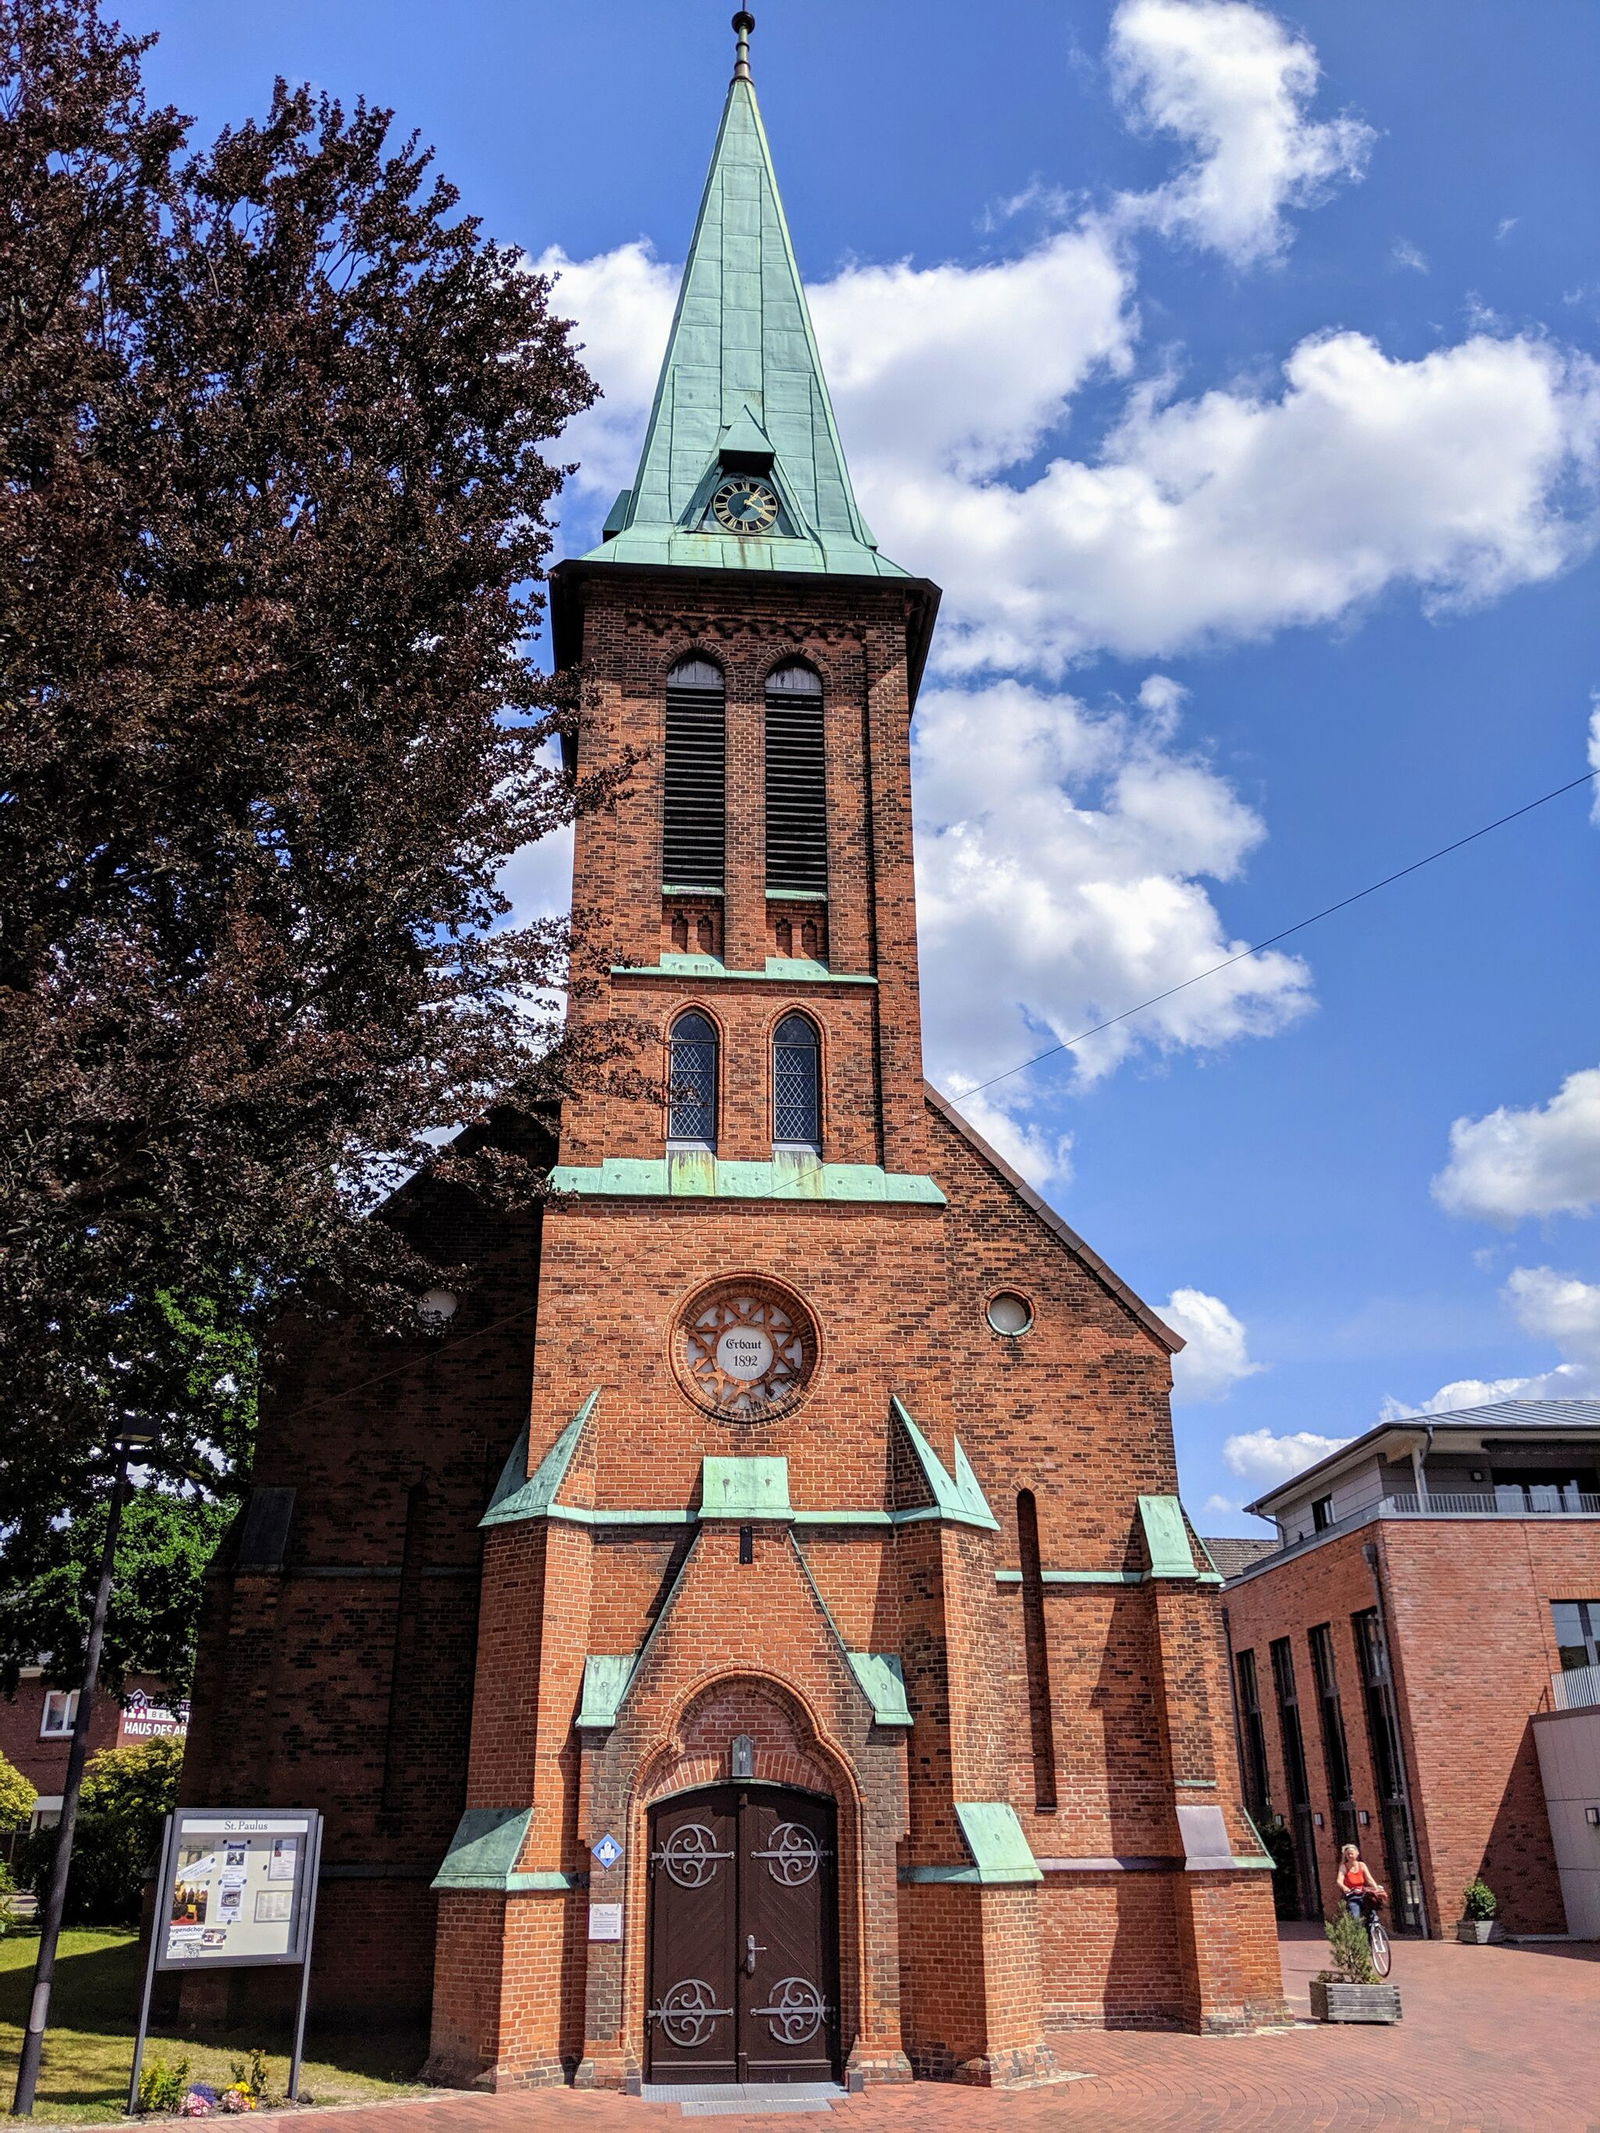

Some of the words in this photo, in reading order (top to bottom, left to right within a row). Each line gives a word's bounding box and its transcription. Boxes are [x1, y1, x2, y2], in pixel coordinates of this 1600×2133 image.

[725, 1338, 762, 1350] Erbaut
[733, 1355, 758, 1367] 1892
[124, 1721, 152, 1735] HAUS
[152, 1723, 173, 1735] DES
[224, 1820, 237, 1830] St.
[238, 1819, 268, 1830] Paulus
[171, 1926, 204, 1934] ugendchor
